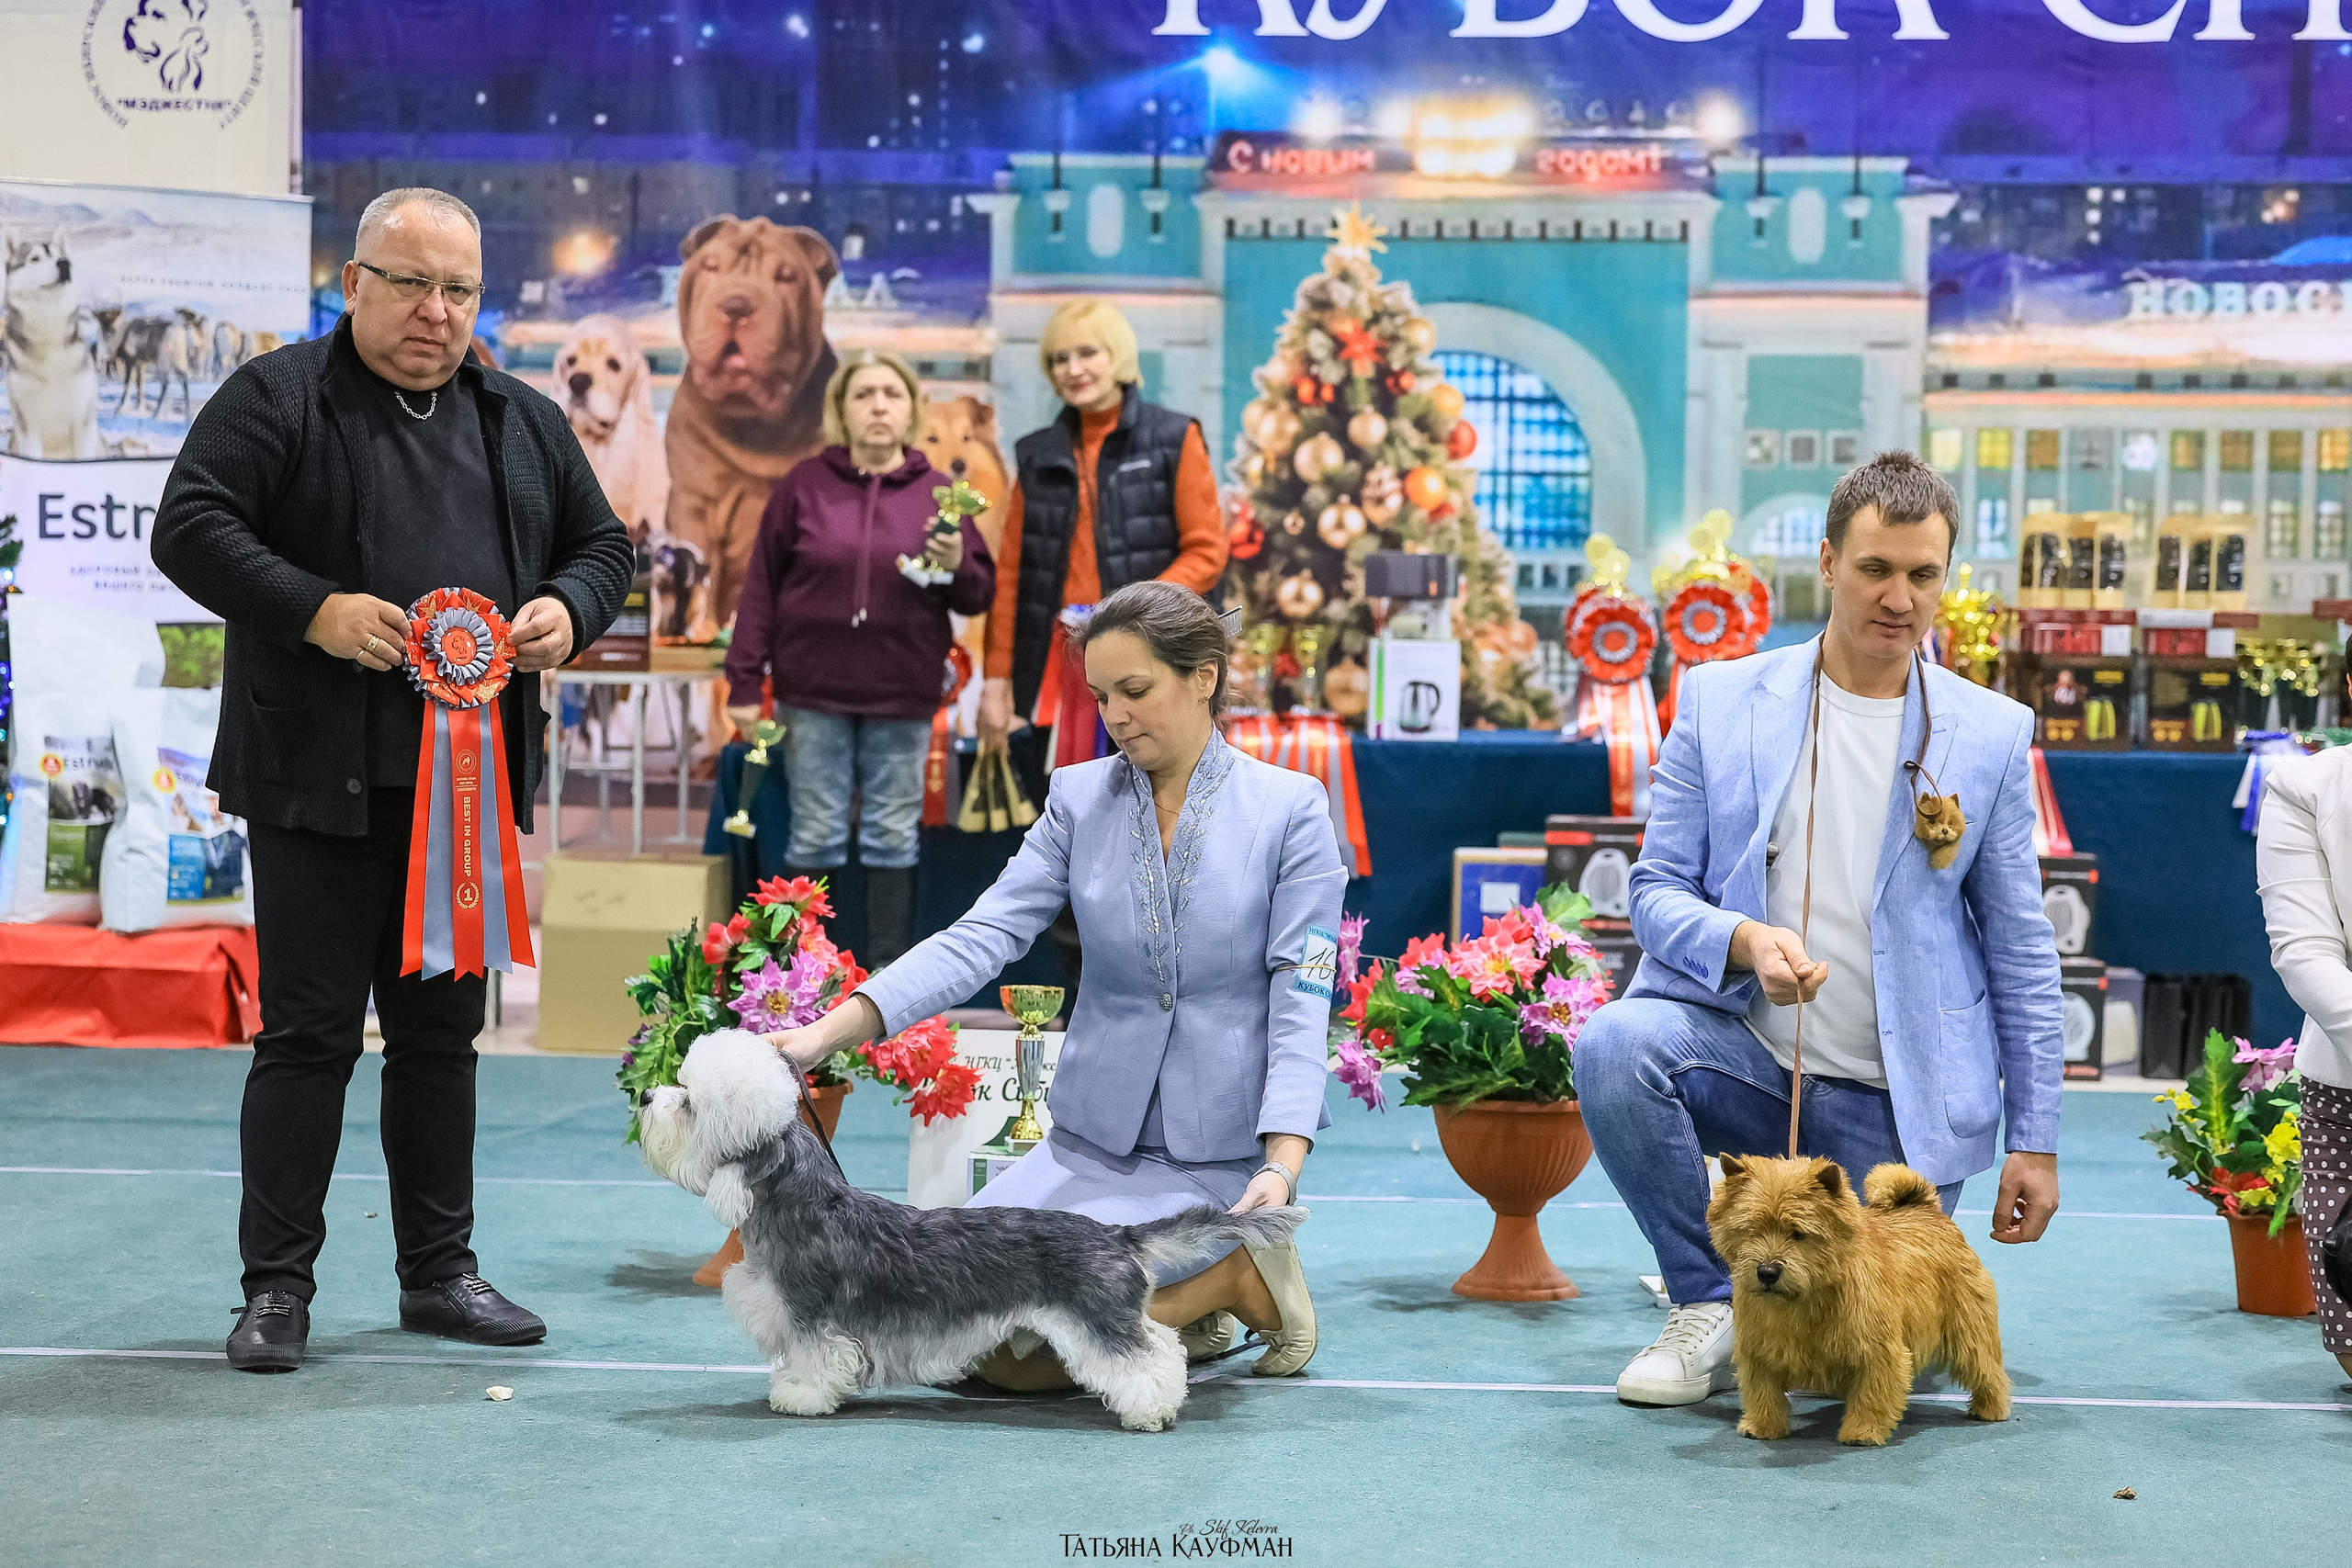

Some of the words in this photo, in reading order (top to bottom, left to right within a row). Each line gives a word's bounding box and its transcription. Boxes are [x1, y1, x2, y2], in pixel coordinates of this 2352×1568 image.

[463, 795, 471, 823] BEST
[463, 825, 471, 837] IN
[463, 839, 472, 877] GROUP
[464, 887, 473, 902] 1
[1298, 981, 1324, 995] КУБОК
[965, 1055, 1002, 1072] НГКЦ
